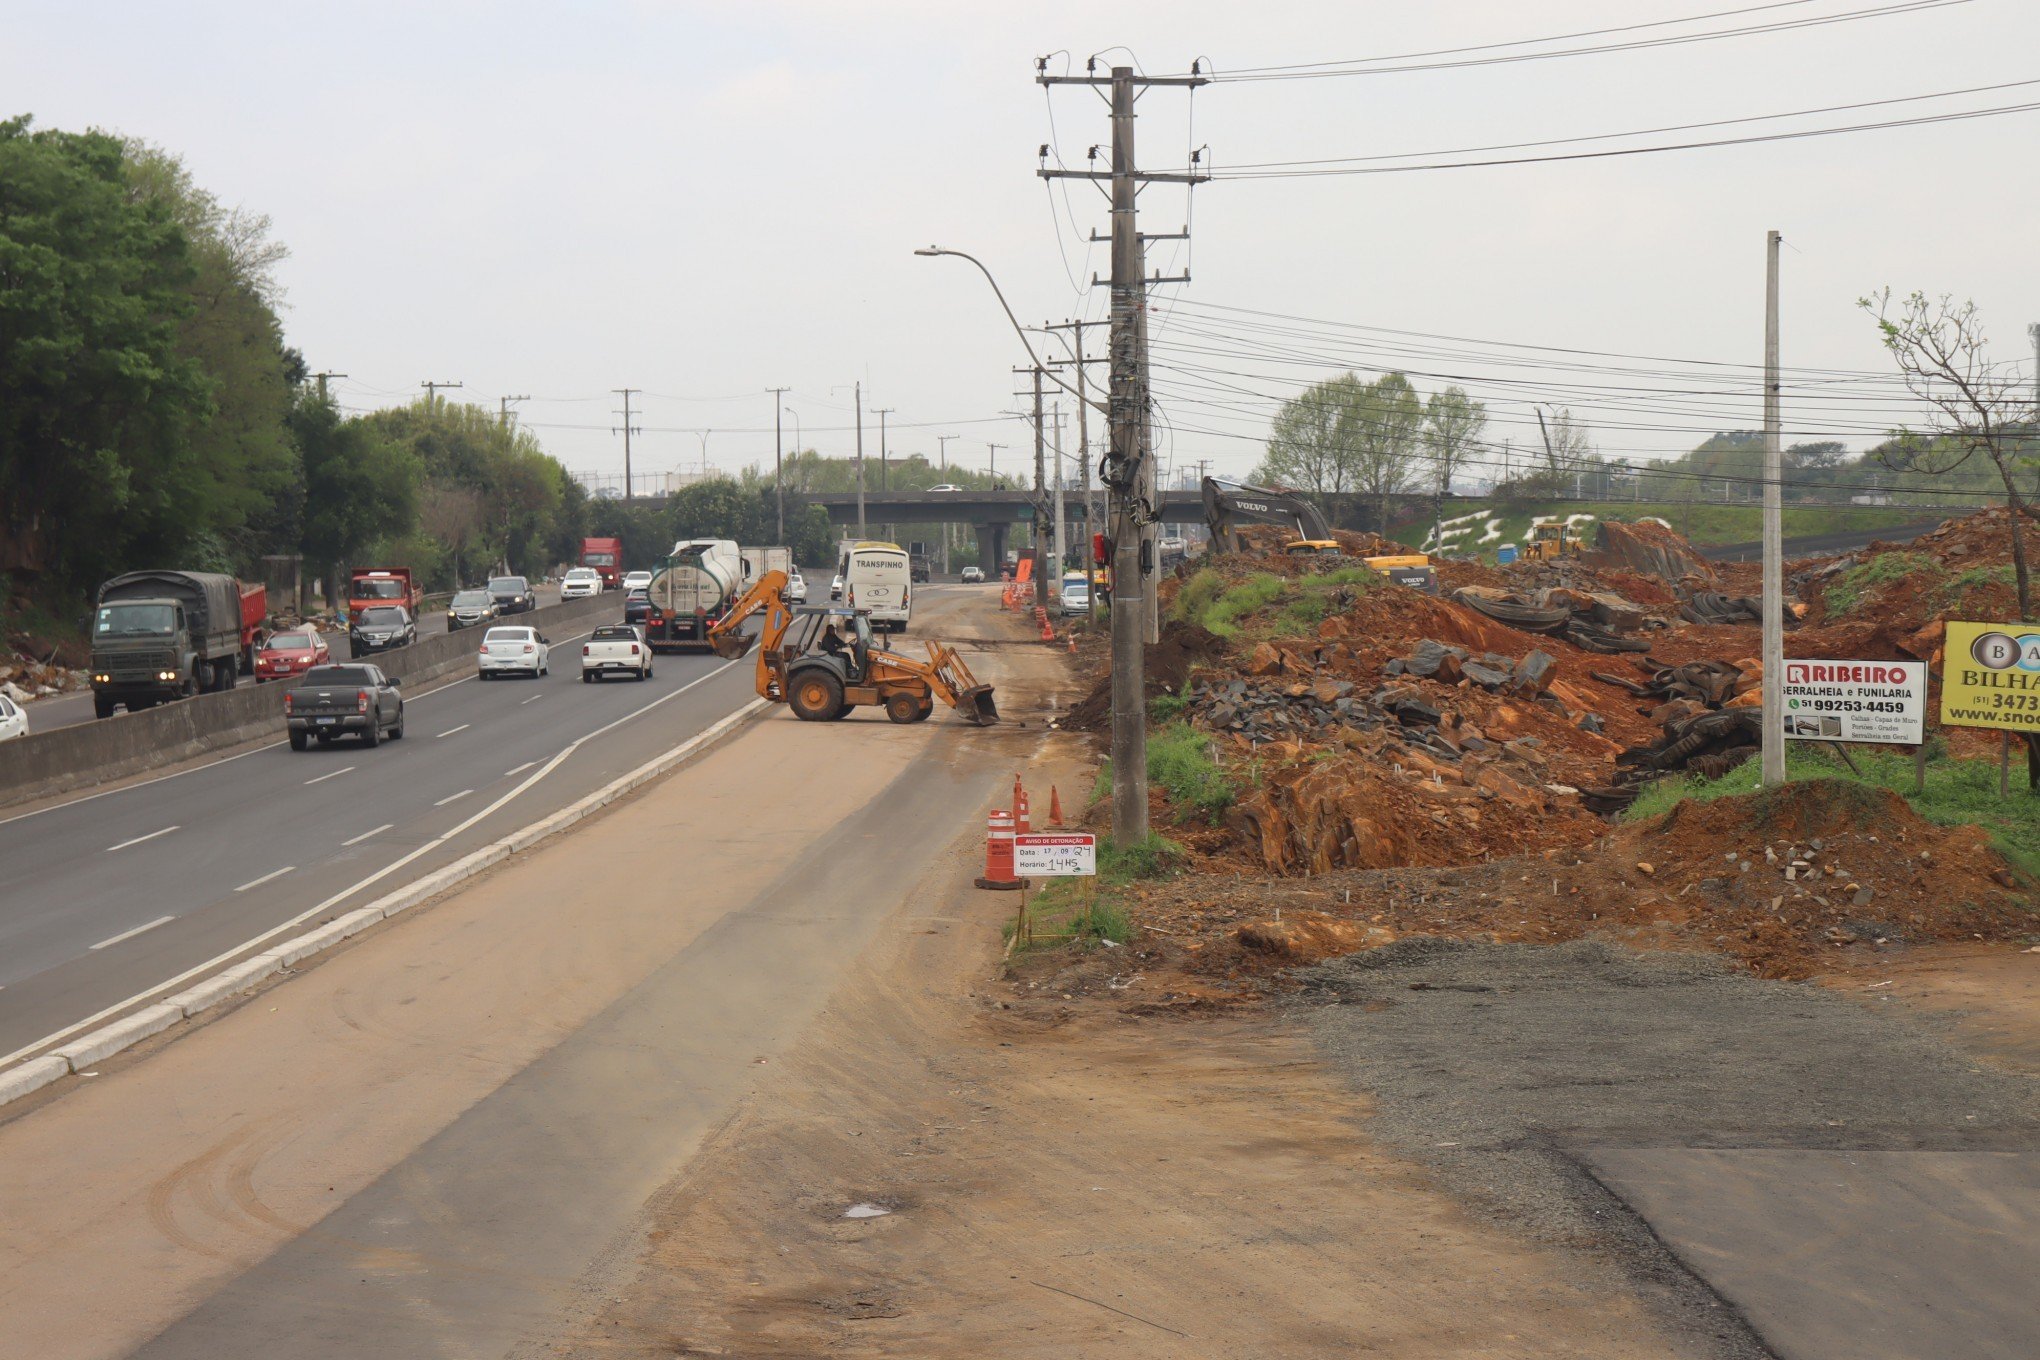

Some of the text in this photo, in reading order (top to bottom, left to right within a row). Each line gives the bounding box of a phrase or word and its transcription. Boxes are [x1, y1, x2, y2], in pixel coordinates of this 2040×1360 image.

[1235, 501, 1268, 512] VOLVO
[856, 560, 903, 569] TRANSPINHO
[746, 599, 763, 615] CASE
[877, 656, 898, 667] CASE
[1812, 665, 1907, 685] RIBEIRO
[1783, 686, 1843, 697] SERRALHEIA
[1857, 687, 1912, 699] FUNILARIA
[1801, 699, 1812, 707] 51
[1875, 716, 1892, 724] Capas
[1051, 837, 1084, 845] DETONAÇÃO
[1019, 860, 1048, 868] Horário:
